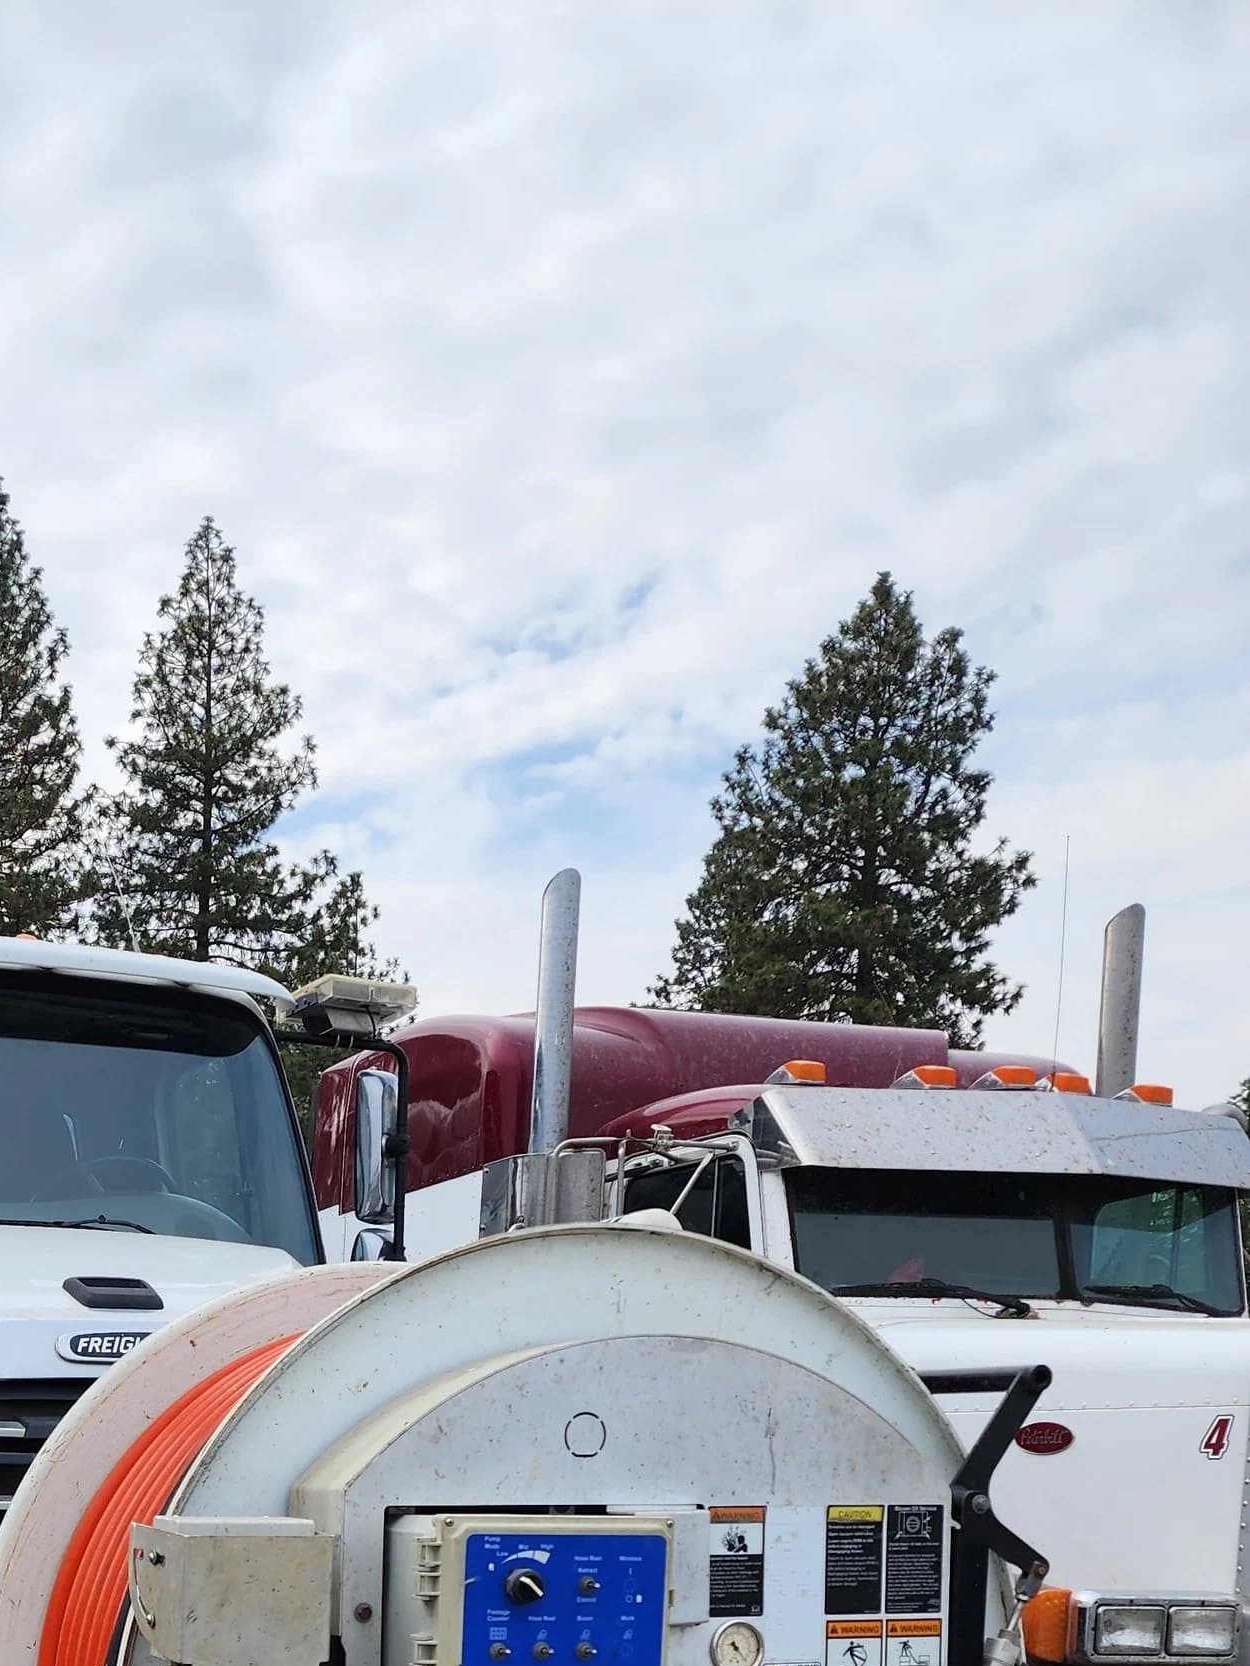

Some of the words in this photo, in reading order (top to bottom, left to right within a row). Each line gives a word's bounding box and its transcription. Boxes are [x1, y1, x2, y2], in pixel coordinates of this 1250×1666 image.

[1200, 1414, 1234, 1460] 4
[838, 1510, 872, 1518] CAUTION
[841, 1625, 880, 1634] WARNING
[900, 1624, 938, 1633] WARNING
